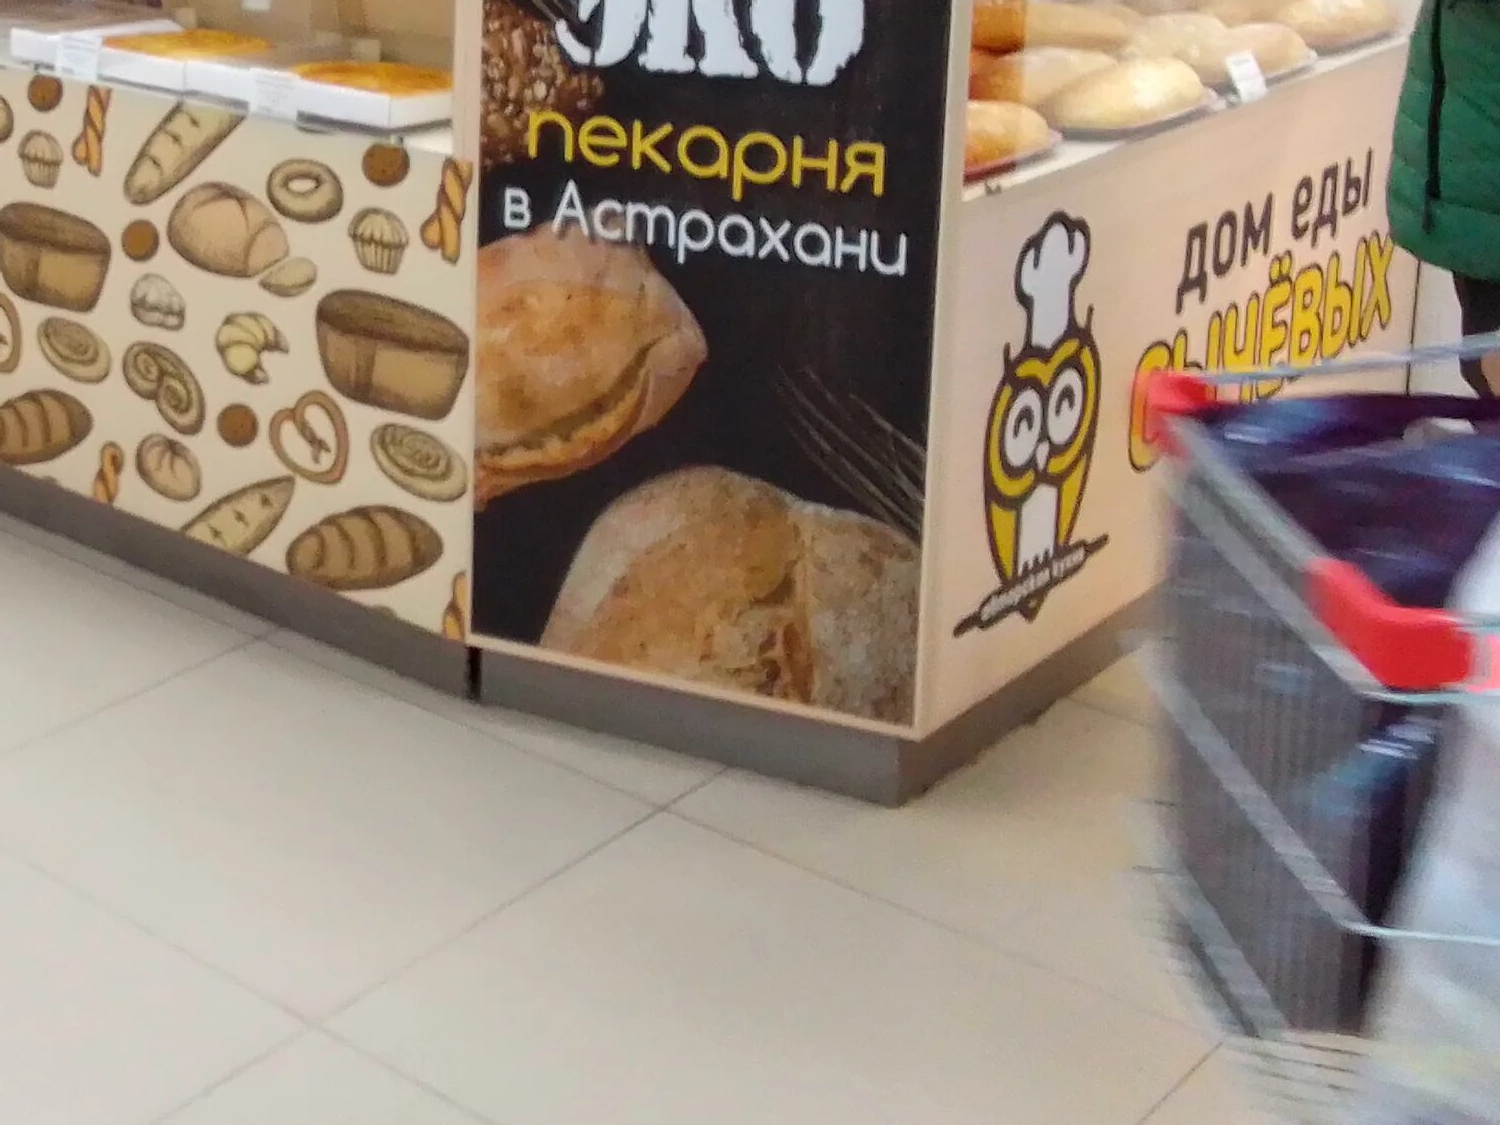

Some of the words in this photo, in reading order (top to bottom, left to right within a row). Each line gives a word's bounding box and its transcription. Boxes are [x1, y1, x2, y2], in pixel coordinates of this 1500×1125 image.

[526, 109, 887, 201] пекарня
[503, 186, 532, 231] в
[551, 178, 908, 276] Астрахани
